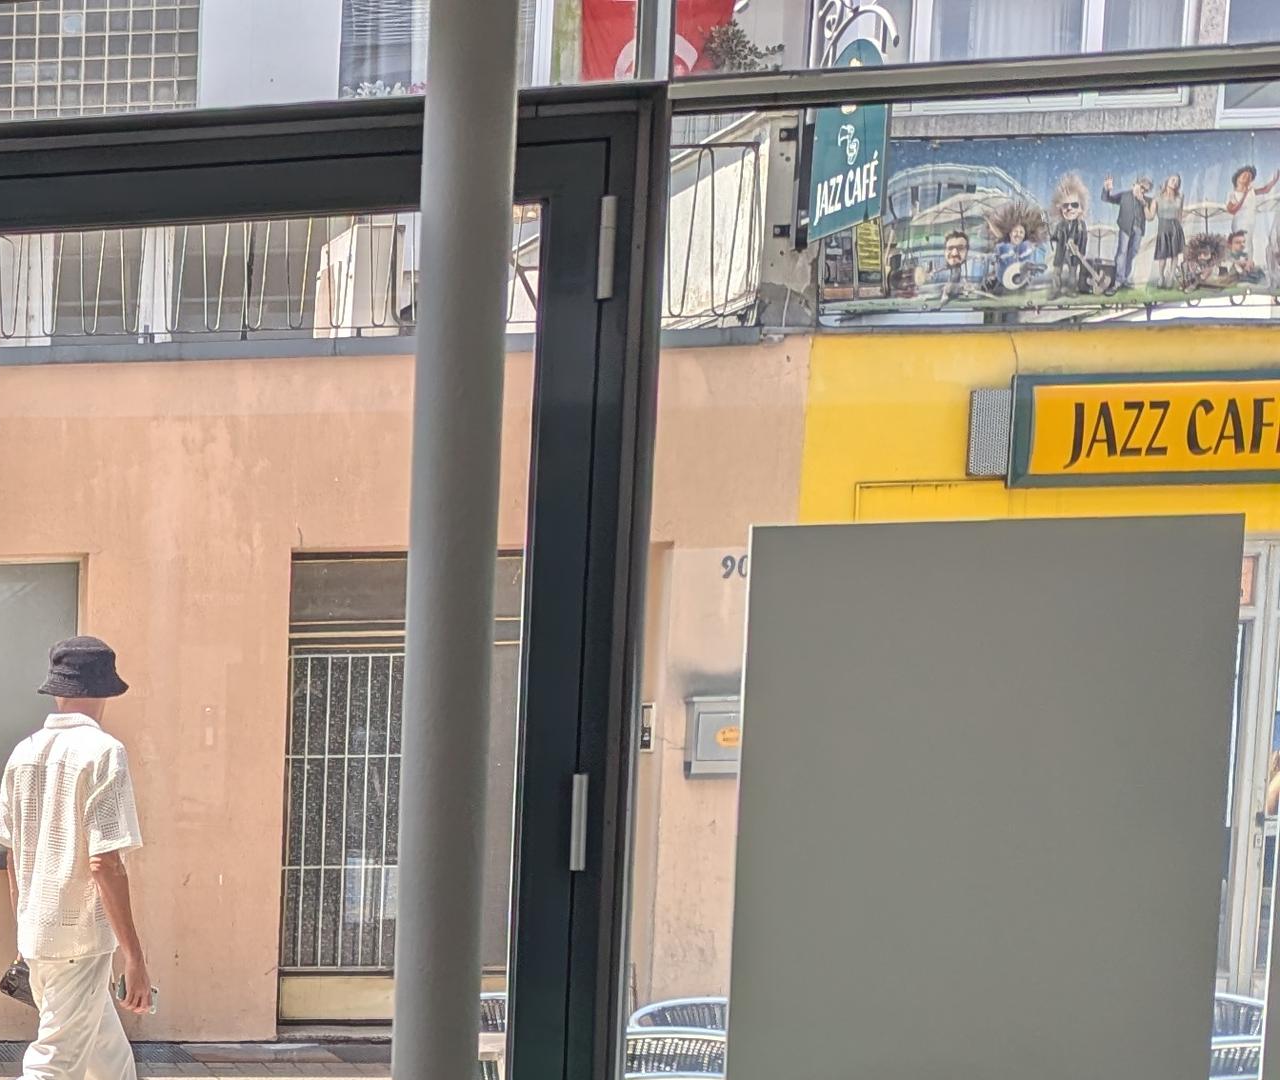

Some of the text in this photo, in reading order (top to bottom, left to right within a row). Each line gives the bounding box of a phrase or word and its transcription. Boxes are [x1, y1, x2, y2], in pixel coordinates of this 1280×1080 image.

[814, 150, 879, 226] JAZZ CAFÉ
[1063, 398, 1280, 469] JAZZ CAF
